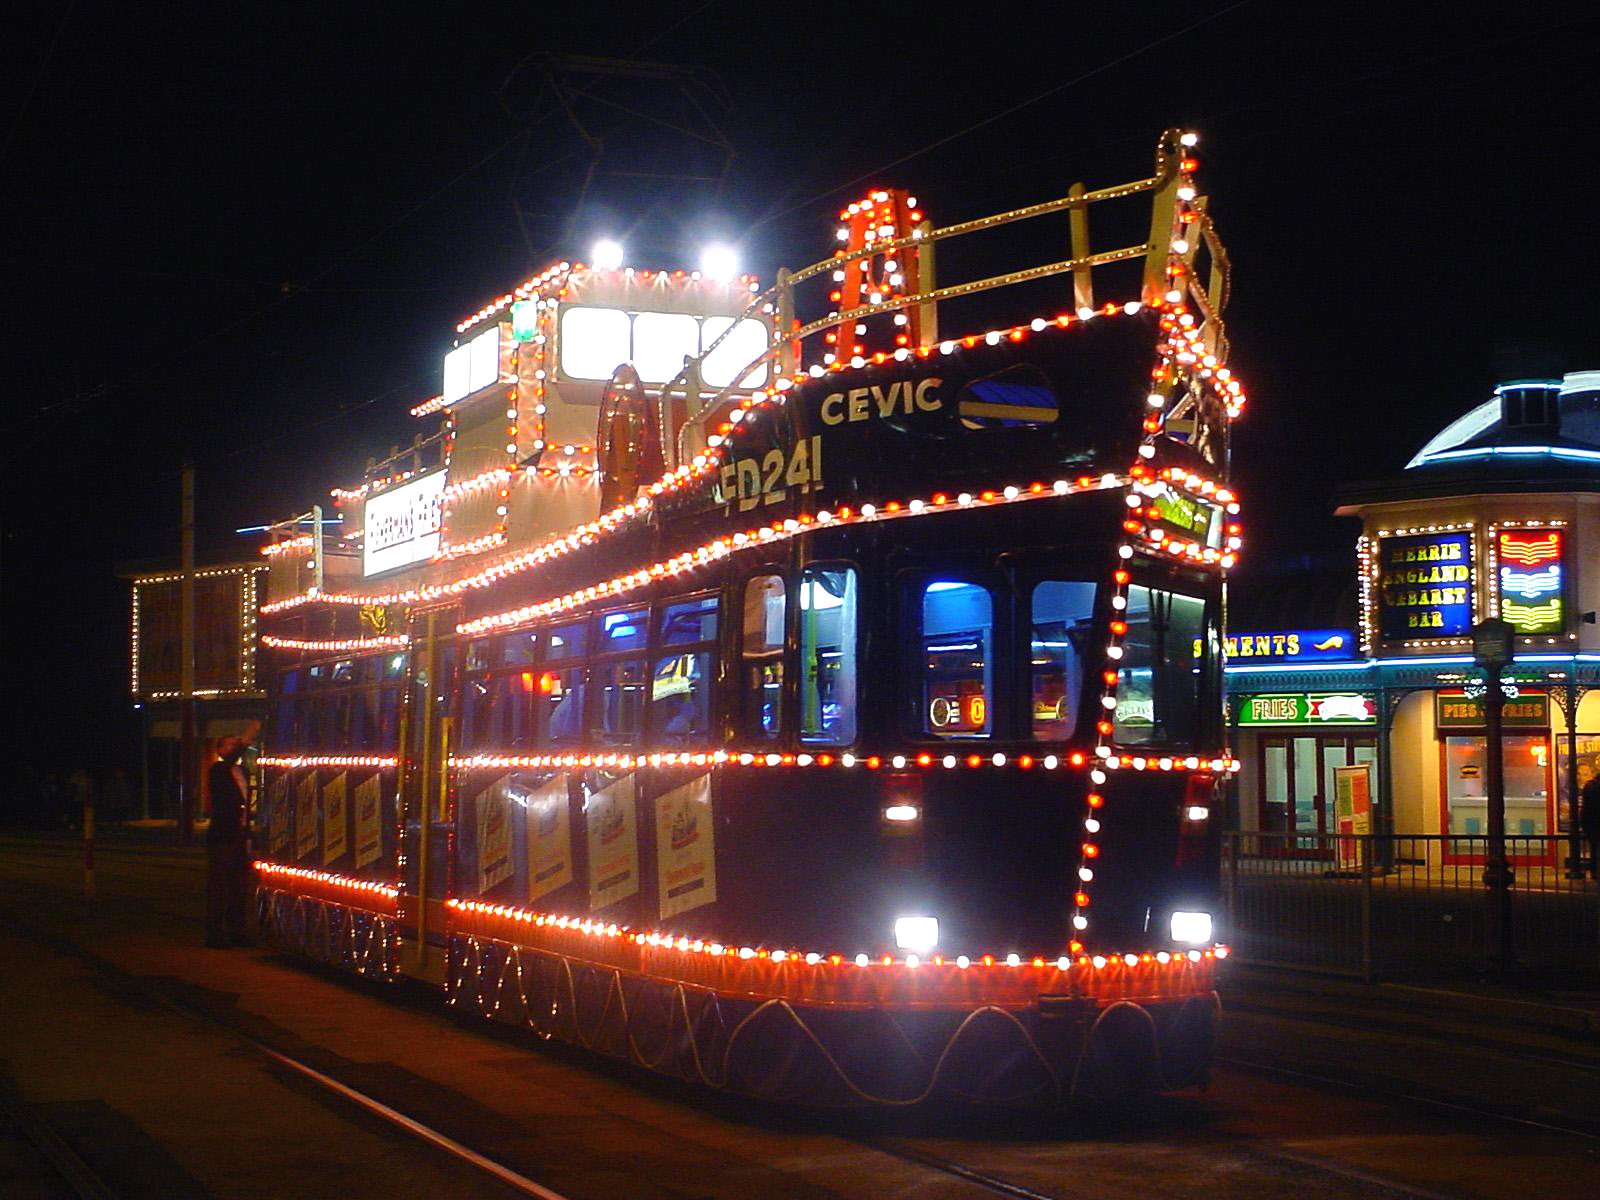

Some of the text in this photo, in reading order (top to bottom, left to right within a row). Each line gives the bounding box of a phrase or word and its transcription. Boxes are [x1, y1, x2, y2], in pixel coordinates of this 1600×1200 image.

[820, 377, 943, 426] CEVIC
[1408, 610, 1444, 627] BAR
[1252, 698, 1298, 720] FRIES
[1443, 703, 1478, 718] PIES
